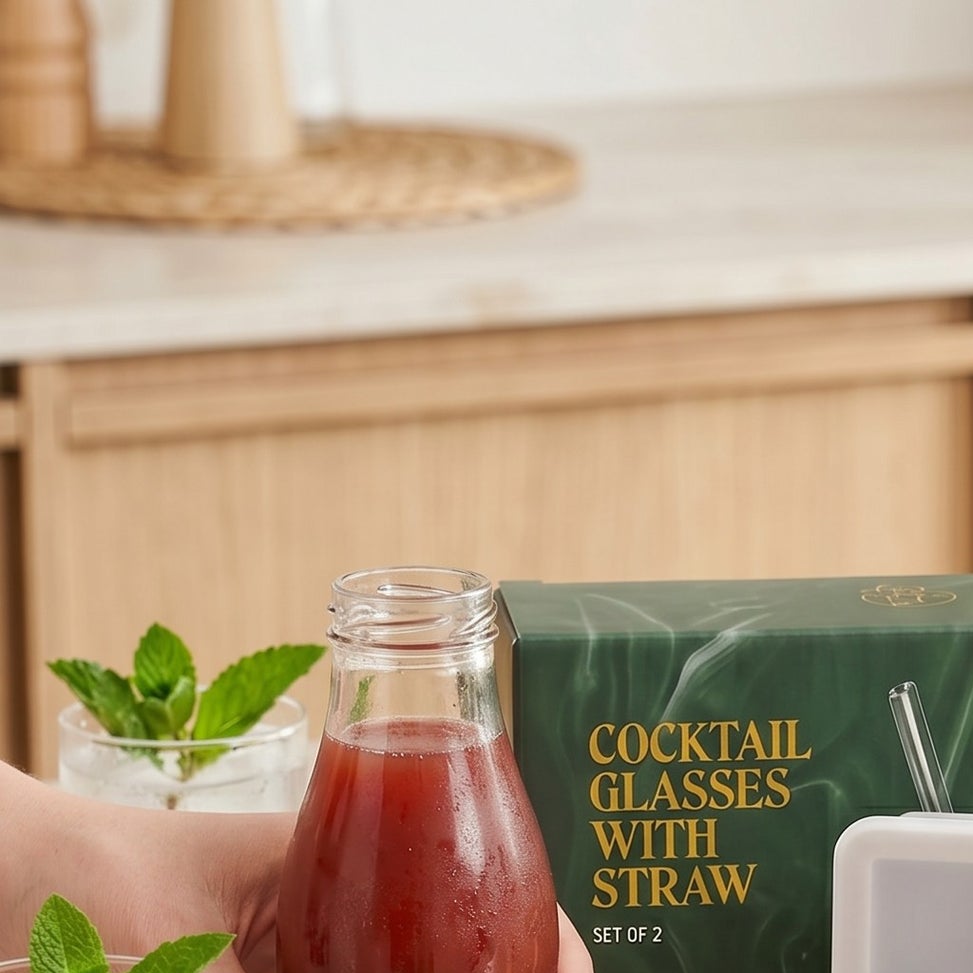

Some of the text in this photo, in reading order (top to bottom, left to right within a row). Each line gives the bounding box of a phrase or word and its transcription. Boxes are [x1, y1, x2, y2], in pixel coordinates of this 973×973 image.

[589, 719, 812, 764] COCKTAIL
[589, 767, 792, 812] GLASSES
[589, 818, 719, 861] WITH
[591, 863, 758, 908] STRAW
[593, 926, 662, 943] SET OF 2
